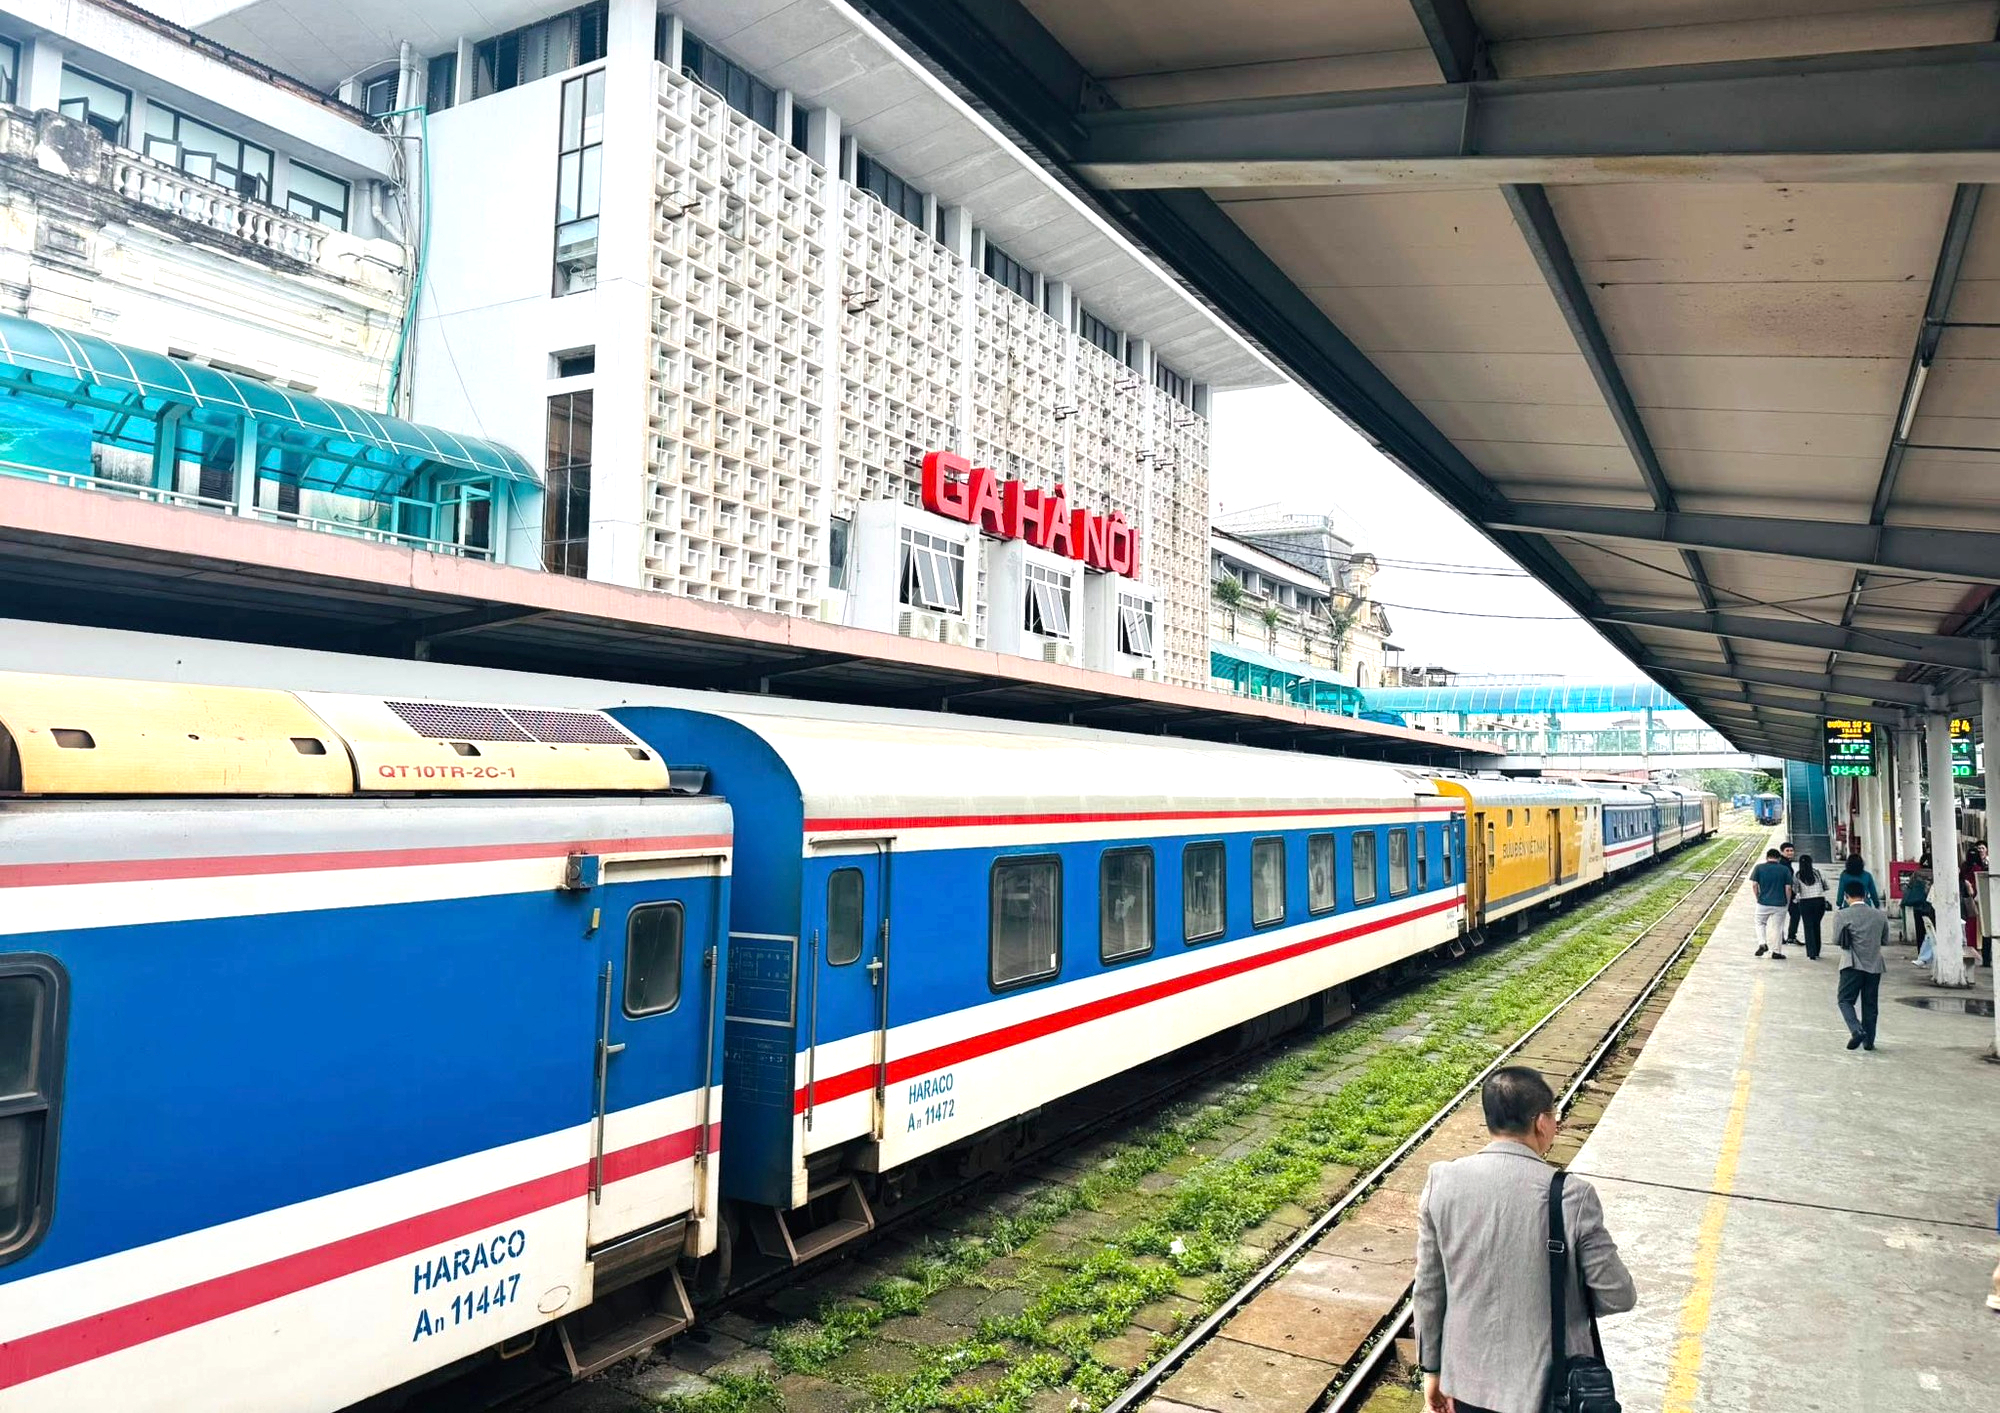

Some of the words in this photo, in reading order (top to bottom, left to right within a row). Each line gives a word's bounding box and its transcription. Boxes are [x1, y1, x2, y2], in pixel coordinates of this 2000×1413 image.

[922, 451, 1006, 535] GA
[1004, 480, 1075, 557] HÀ
[1863, 721, 1872, 733] 3
[1961, 720, 1970, 732] 4
[1840, 744, 1870, 754] LP2
[908, 1073, 954, 1105] HARACO
[925, 1099, 955, 1126] 11472
[413, 1229, 525, 1295] HARACO
[451, 1273, 521, 1325] 11447
